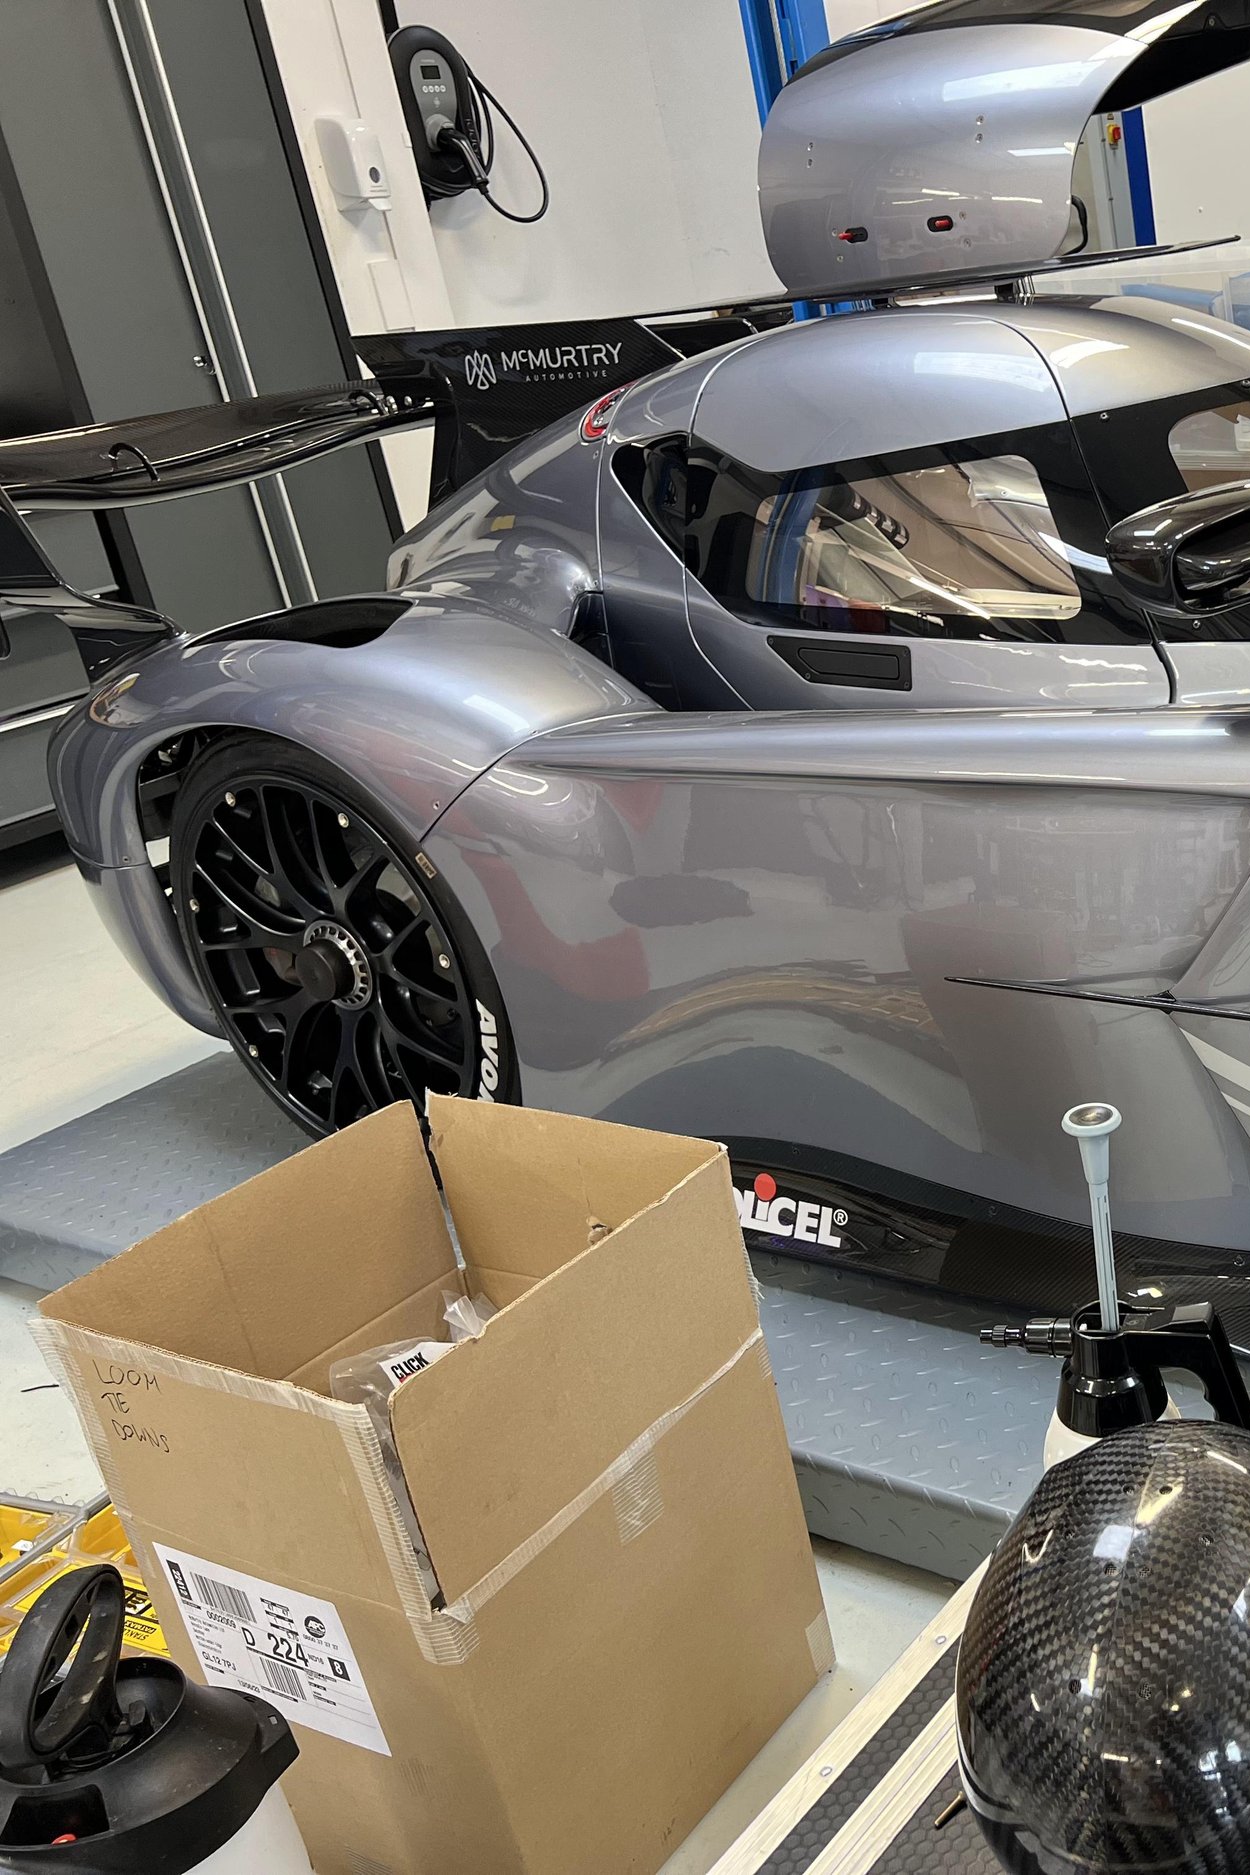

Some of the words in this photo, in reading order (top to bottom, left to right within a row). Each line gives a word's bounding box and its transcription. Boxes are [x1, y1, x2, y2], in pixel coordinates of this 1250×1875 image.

[525, 369, 608, 383] AUTOMOTIVE
[91, 1359, 163, 1394] LOOM
[390, 1351, 430, 1380] CLICK
[111, 1418, 170, 1454] DOWNS
[124, 1628, 150, 1641] STANL
[125, 1620, 156, 1634] FATMAX
[201, 1650, 223, 1667] GL12
[222, 1657, 238, 1672] 7PJ
[241, 1626, 256, 1647] D
[266, 1632, 309, 1668] 224
[334, 1661, 344, 1676] 8
